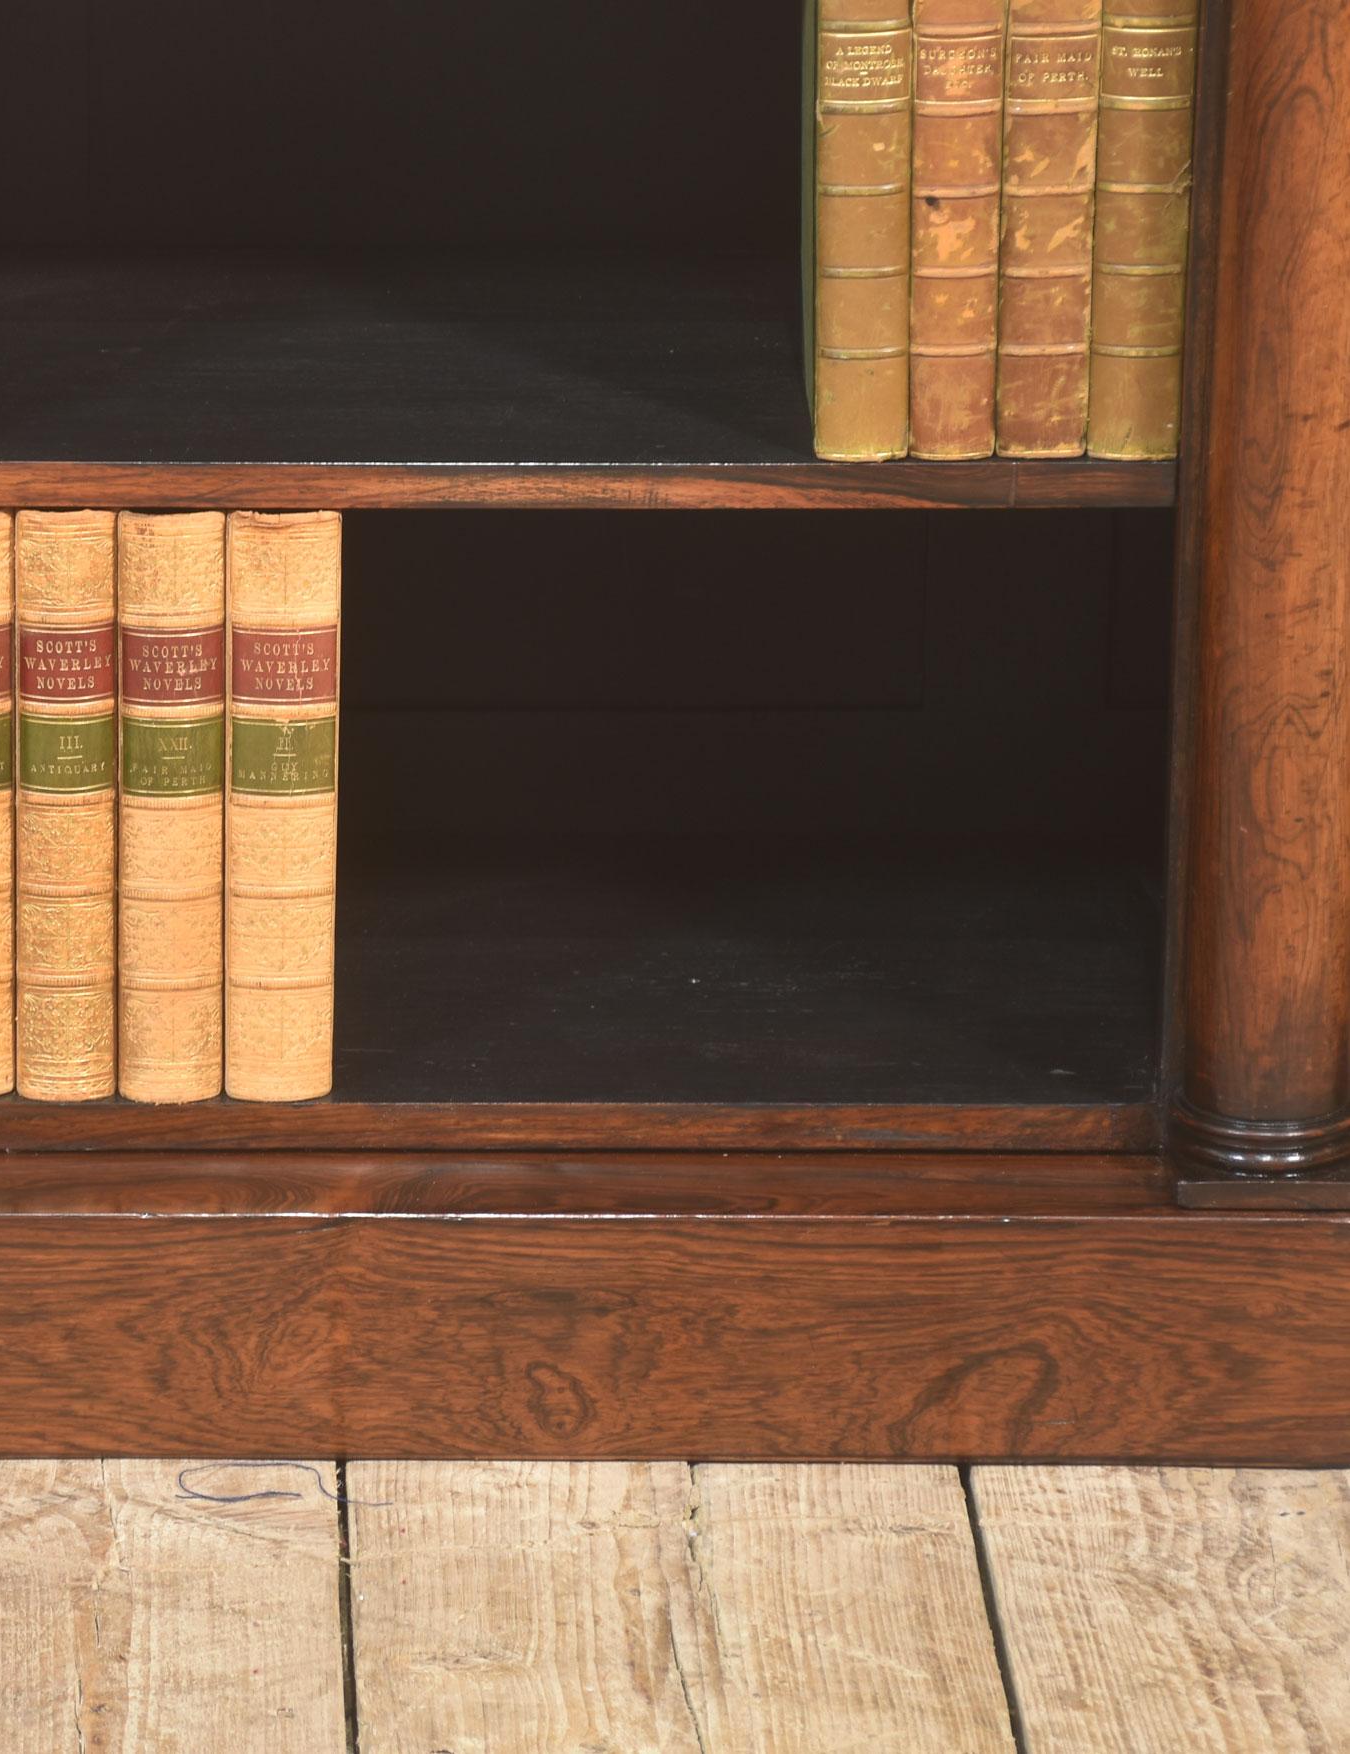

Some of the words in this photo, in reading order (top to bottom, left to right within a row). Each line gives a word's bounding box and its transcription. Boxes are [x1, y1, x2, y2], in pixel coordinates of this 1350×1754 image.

[835, 47, 844, 56] A
[847, 44, 892, 56] LEGEND
[919, 47, 997, 60] SURGEON'S
[826, 60, 838, 70] OF
[1015, 53, 1050, 64] FAIR
[1056, 52, 1092, 64] MAID
[1018, 72, 1035, 83] OF
[1042, 71, 1090, 83] PERTH.
[1127, 67, 1164, 78] WELL
[862, 74, 903, 86] DWARF
[36, 639, 97, 654] SCOTT'S
[142, 643, 203, 658] SCOTT'S
[254, 642, 315, 656] SCOTT'S
[24, 654, 112, 672] WAVERLEY
[129, 657, 218, 675] WAVERLEY
[240, 657, 331, 674] WAVERLEY
[36, 676, 95, 690] NOVELS
[142, 677, 202, 691] NOVELS
[254, 677, 314, 692] NOVELS
[59, 735, 83, 750] III.
[158, 737, 193, 752] XXII.
[30, 761, 106, 775] ANTIQUARY
[130, 763, 168, 775] FAIR
[270, 762, 299, 772] GUY
[140, 777, 153, 787] OF
[163, 775, 206, 787] PERTH
[237, 769, 329, 782] MANNERING
